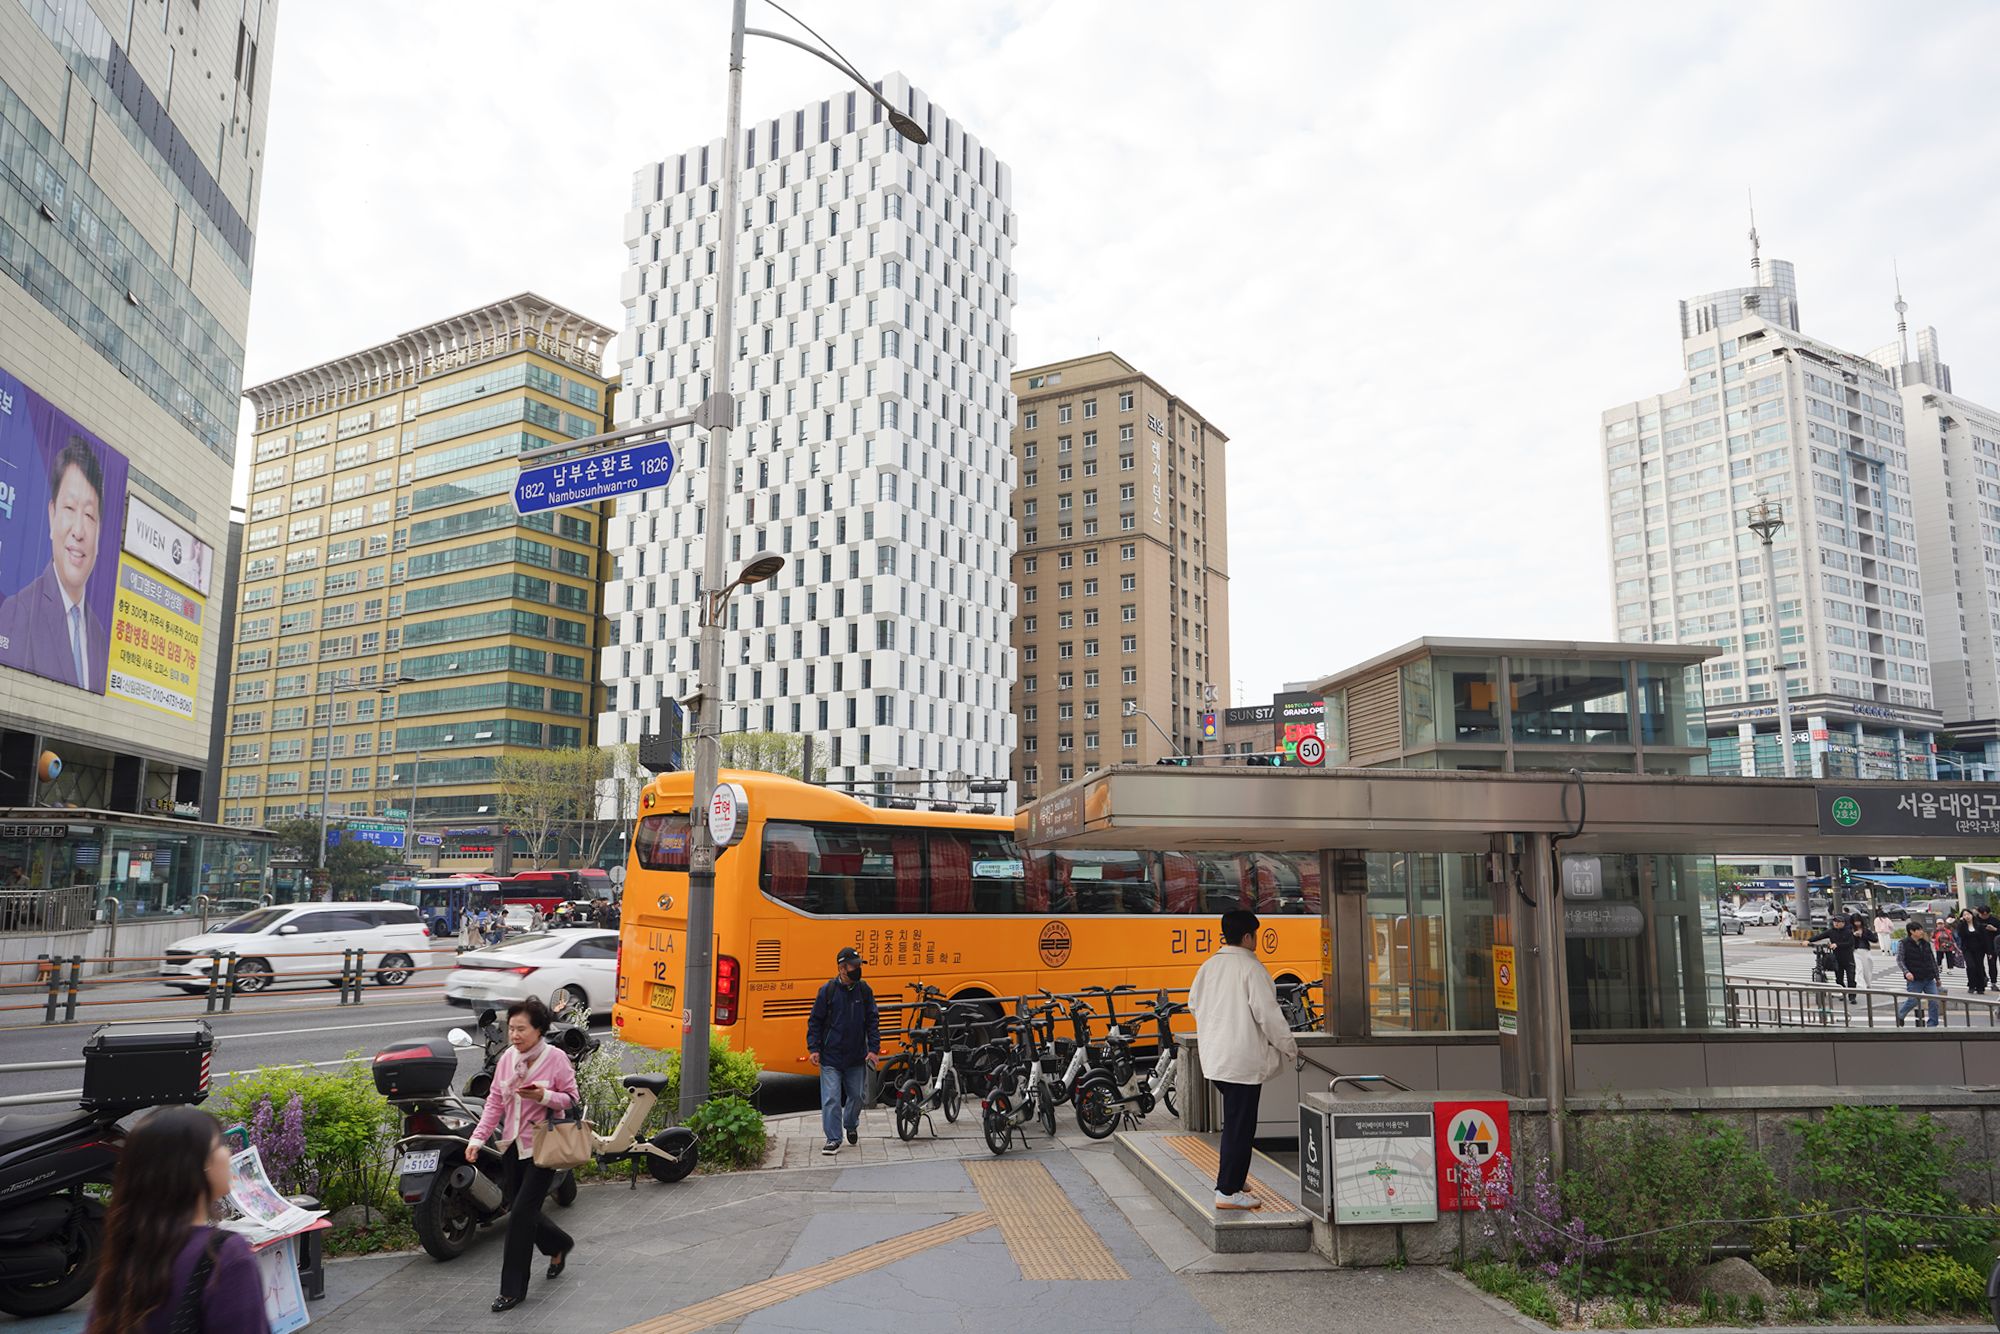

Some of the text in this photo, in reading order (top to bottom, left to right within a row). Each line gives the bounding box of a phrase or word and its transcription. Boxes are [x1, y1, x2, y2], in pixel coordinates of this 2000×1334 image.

[519, 454, 669, 500] 1822 남부순환로 1826
[547, 478, 639, 504] Nambusunhwan-ro
[136, 518, 166, 551] VIVIEN
[116, 619, 149, 649] 종합병원
[150, 634, 166, 656] 의원
[183, 649, 197, 671] 가능
[1283, 707, 1308, 716] GRAND
[1302, 743, 1319, 757] 50
[714, 794, 730, 821] 금연
[1838, 801, 1853, 809] 228
[1897, 792, 2000, 818] 서울대입구
[1836, 810, 1857, 820] 2호선
[1956, 820, 2000, 833] (관악구청
[1564, 910, 1612, 922] 서울대입구
[649, 931, 674, 953] LILA
[653, 961, 666, 980] 12
[1355, 1120, 1409, 1130] 엘리베이터 이용안내
[411, 1160, 435, 1170] 5102
